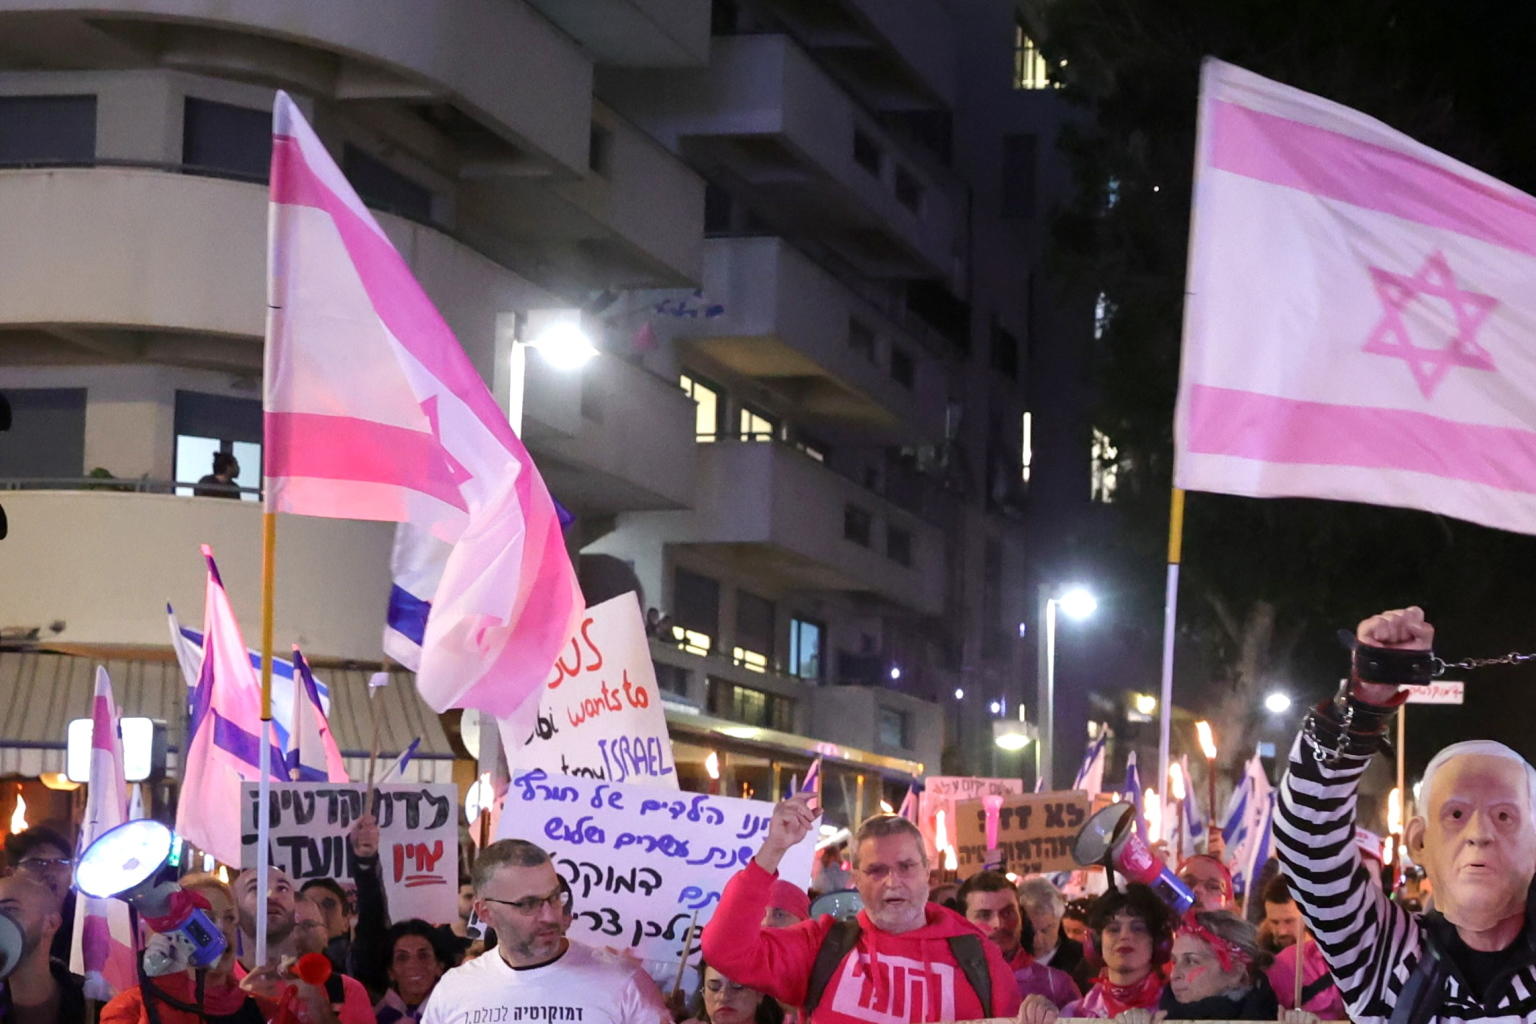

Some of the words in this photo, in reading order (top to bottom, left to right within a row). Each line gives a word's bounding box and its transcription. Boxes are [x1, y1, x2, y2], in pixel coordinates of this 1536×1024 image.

[567, 681, 622, 727] wants
[623, 669, 648, 708] to
[598, 736, 672, 783] ISRAEL
[591, 784, 624, 809] של
[640, 795, 724, 826] הילדים
[1045, 803, 1085, 828] לא
[276, 835, 354, 879] ועד
[392, 840, 443, 883] אין
[687, 845, 753, 868] שנת
[631, 914, 691, 947] לכן
[514, 1005, 583, 1024] דמוקרטיה
